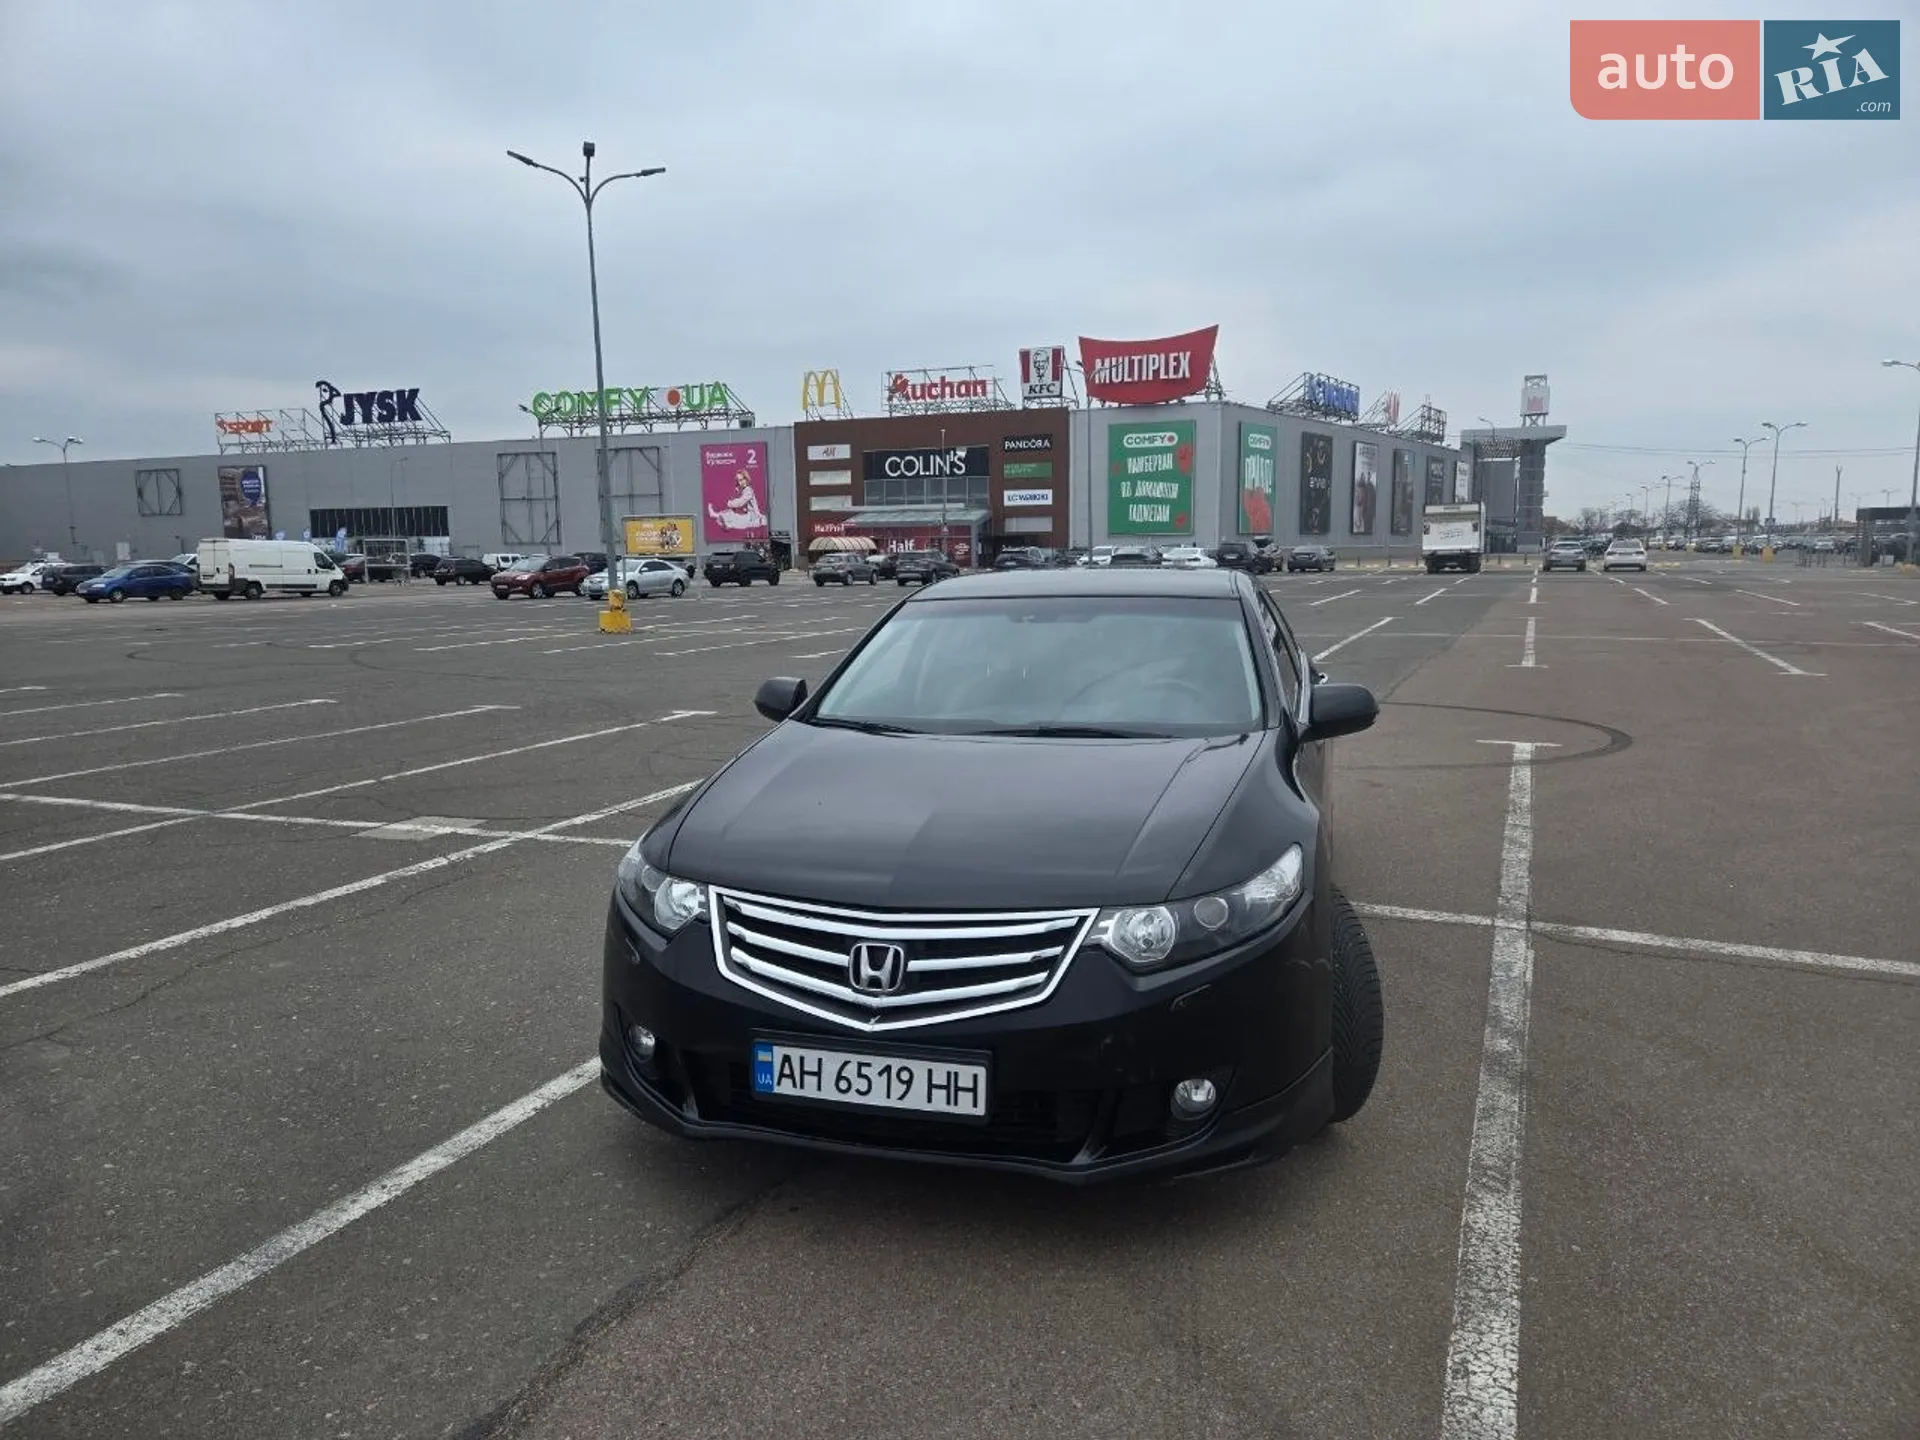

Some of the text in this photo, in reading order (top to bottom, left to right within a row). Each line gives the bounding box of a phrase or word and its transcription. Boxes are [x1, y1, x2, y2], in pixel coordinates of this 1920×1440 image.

[1094, 351, 1191, 384] MULTIPLEX
[887, 373, 987, 402] Auchan
[1027, 382, 1056, 395] KFC
[340, 388, 423, 426] JYSK
[532, 385, 651, 420] COMFY
[1004, 438, 1051, 450] PANDORA
[1125, 434, 1167, 445] COMFY
[747, 448, 758, 464] 2
[884, 452, 967, 477] COLIN'S
[757, 1072, 773, 1086] UA
[776, 1053, 978, 1109] AH 6519 HH
